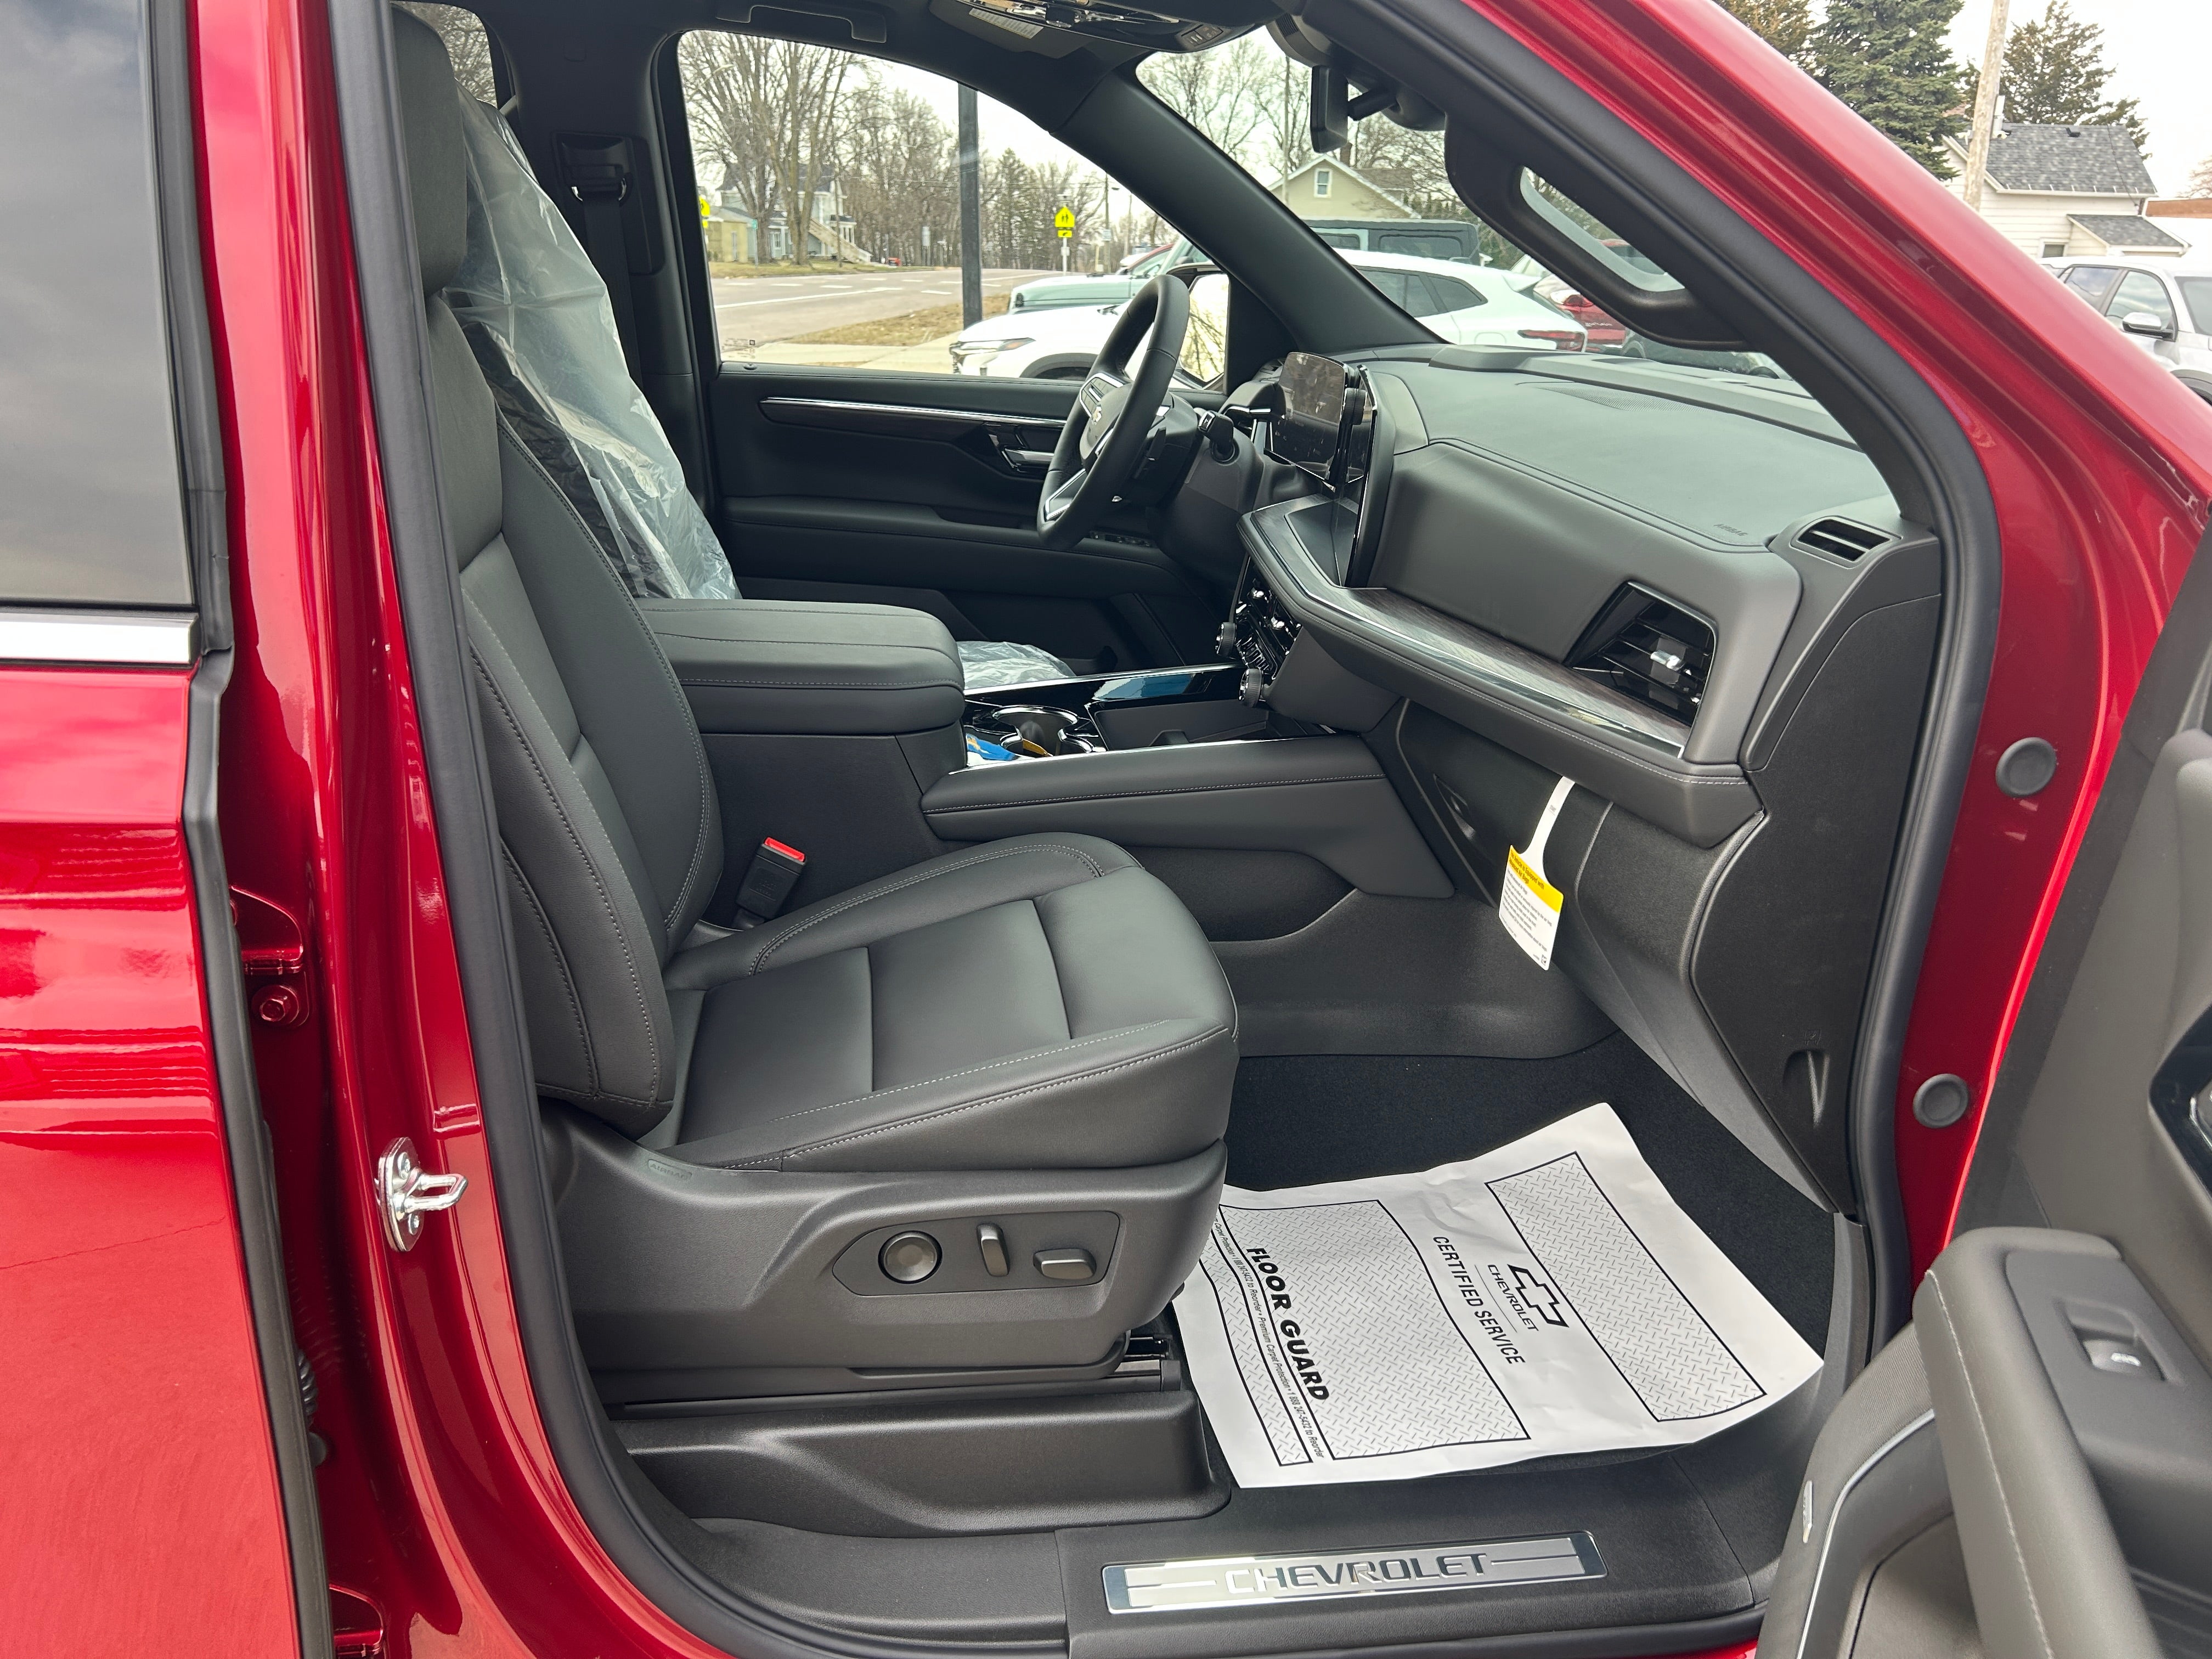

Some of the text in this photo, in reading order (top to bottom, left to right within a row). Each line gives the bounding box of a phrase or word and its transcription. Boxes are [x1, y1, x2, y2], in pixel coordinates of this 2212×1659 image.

[1713, 523, 1748, 537] AIRBAG
[650, 1164, 689, 1179] AIRBAG
[1246, 1248, 1330, 1400] FLOOR GUARD
[1433, 1237, 1526, 1364] CERTIFIED SERVICE
[1487, 1265, 1539, 1331] CHEVROLET
[1249, 1288, 1262, 1313] Reorder
[1257, 1317, 1271, 1343] Premium
[1267, 1344, 1279, 1365] Carpet
[1273, 1361, 1290, 1390] Protection
[1308, 1436, 1324, 1458] Reorder
[1224, 1553, 1488, 1594] CHEVROLET
